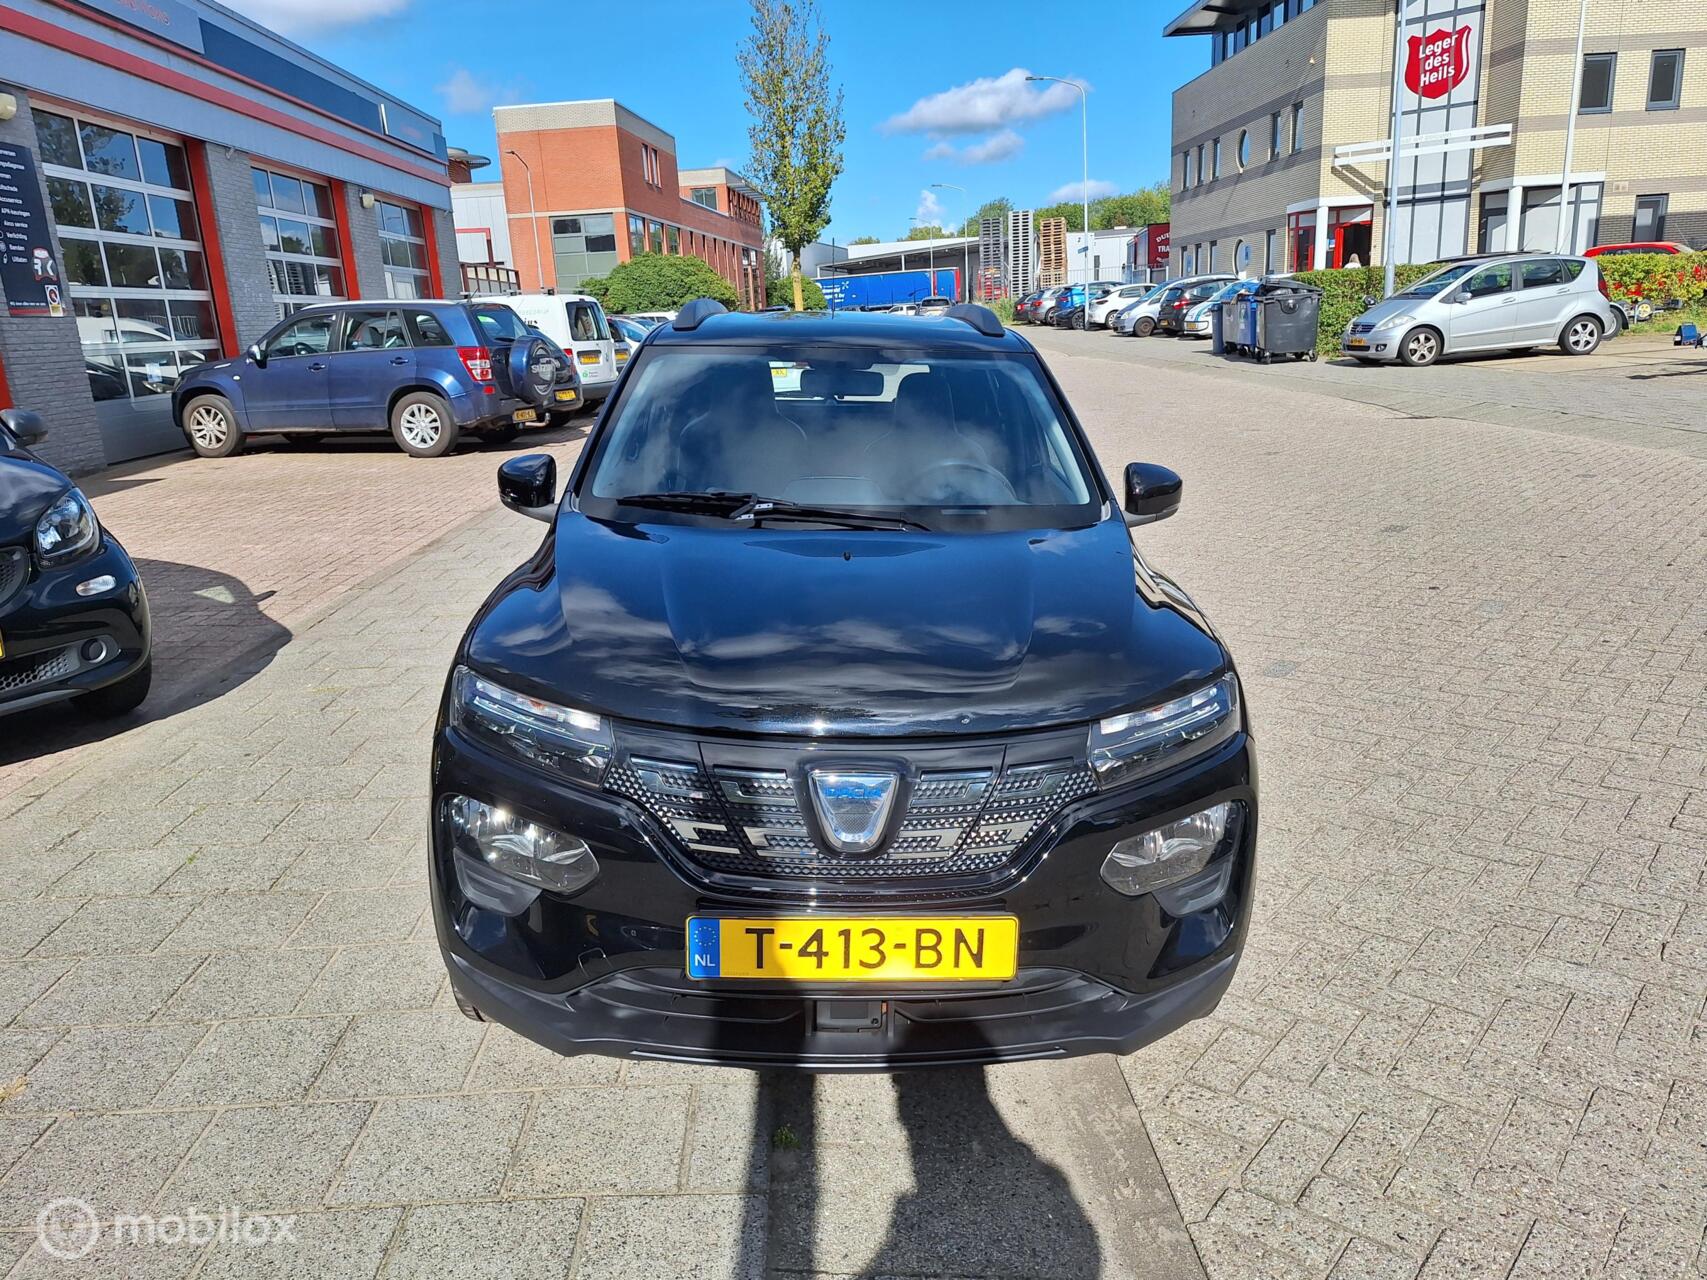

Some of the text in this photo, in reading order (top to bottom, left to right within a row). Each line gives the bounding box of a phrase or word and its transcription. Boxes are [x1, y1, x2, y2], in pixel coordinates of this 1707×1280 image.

[1419, 34, 1458, 59] Leger
[1425, 52, 1450, 71] des
[1420, 65, 1456, 87] Heils
[745, 928, 984, 969] T-413-BN
[694, 954, 716, 967] NL
